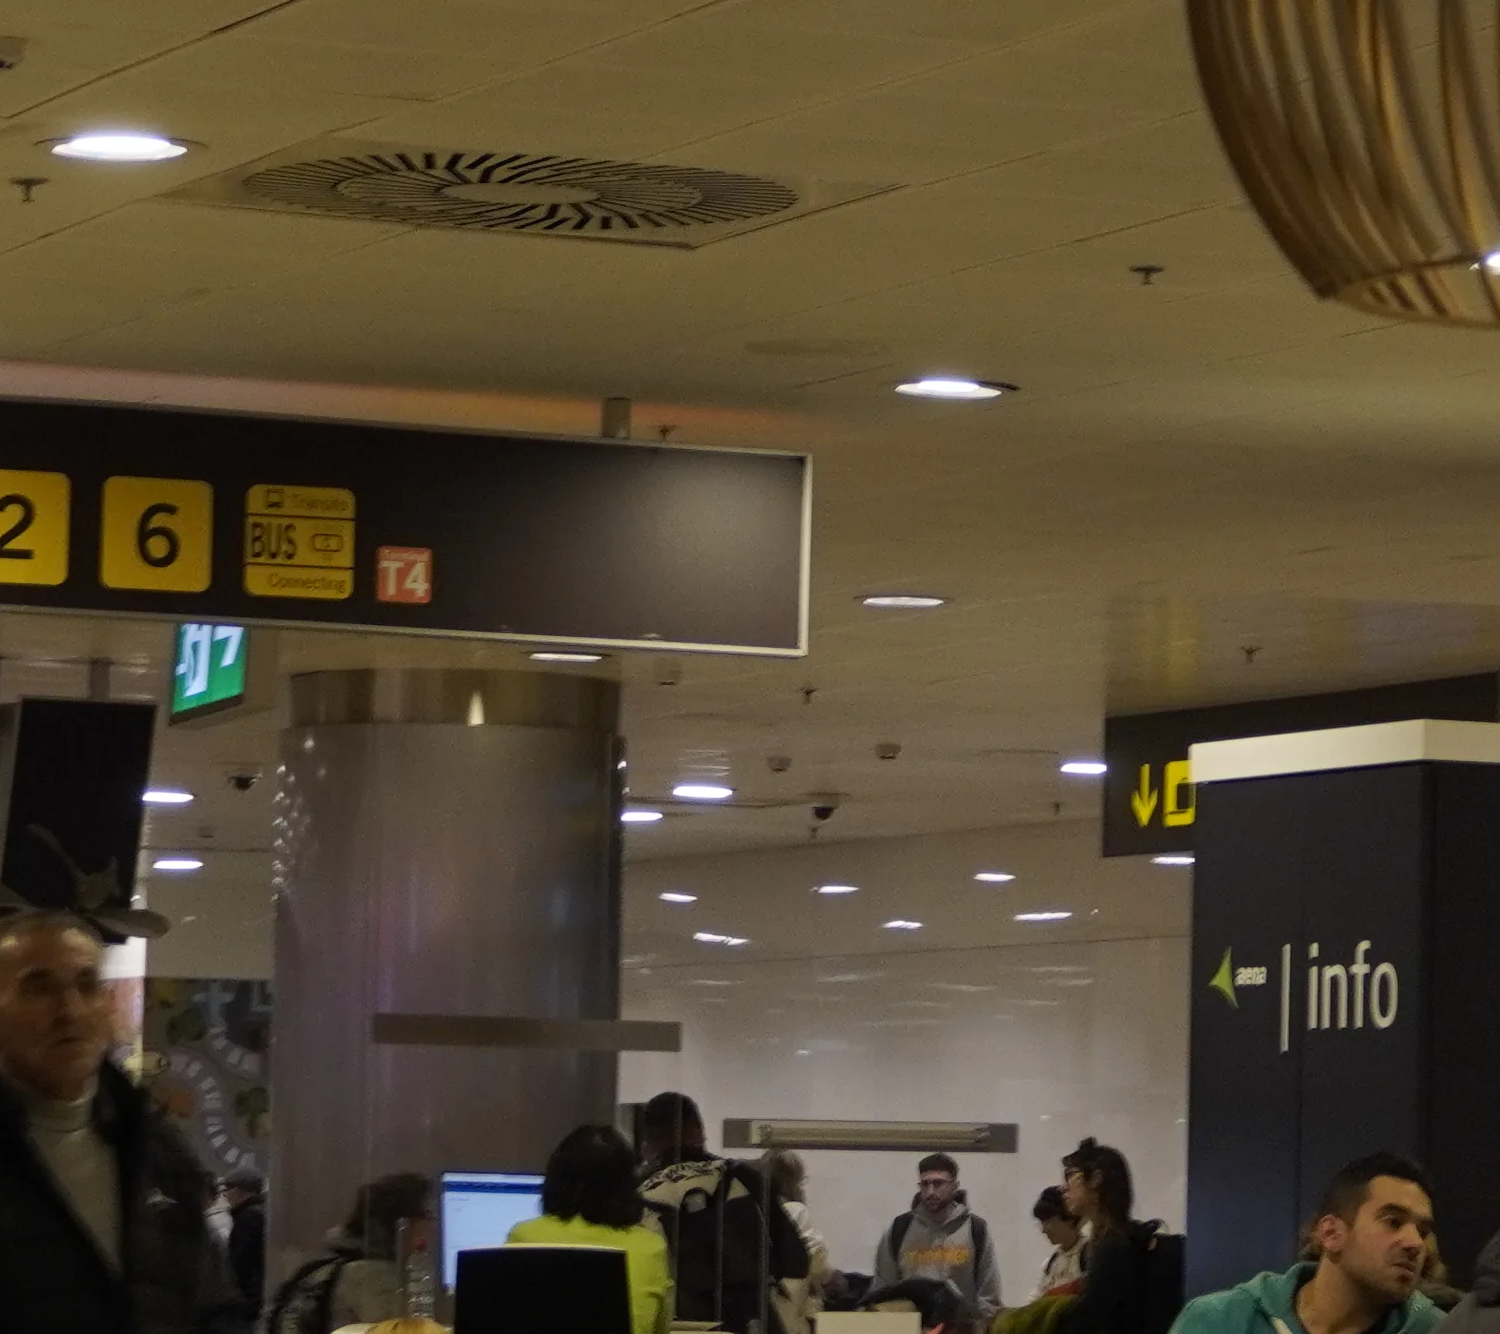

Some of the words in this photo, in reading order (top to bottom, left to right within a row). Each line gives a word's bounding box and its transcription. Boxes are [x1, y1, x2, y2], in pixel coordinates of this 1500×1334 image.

[135, 502, 181, 568] 6
[250, 522, 298, 560] BUS
[377, 560, 431, 598] T4
[1306, 939, 1399, 1030] info
